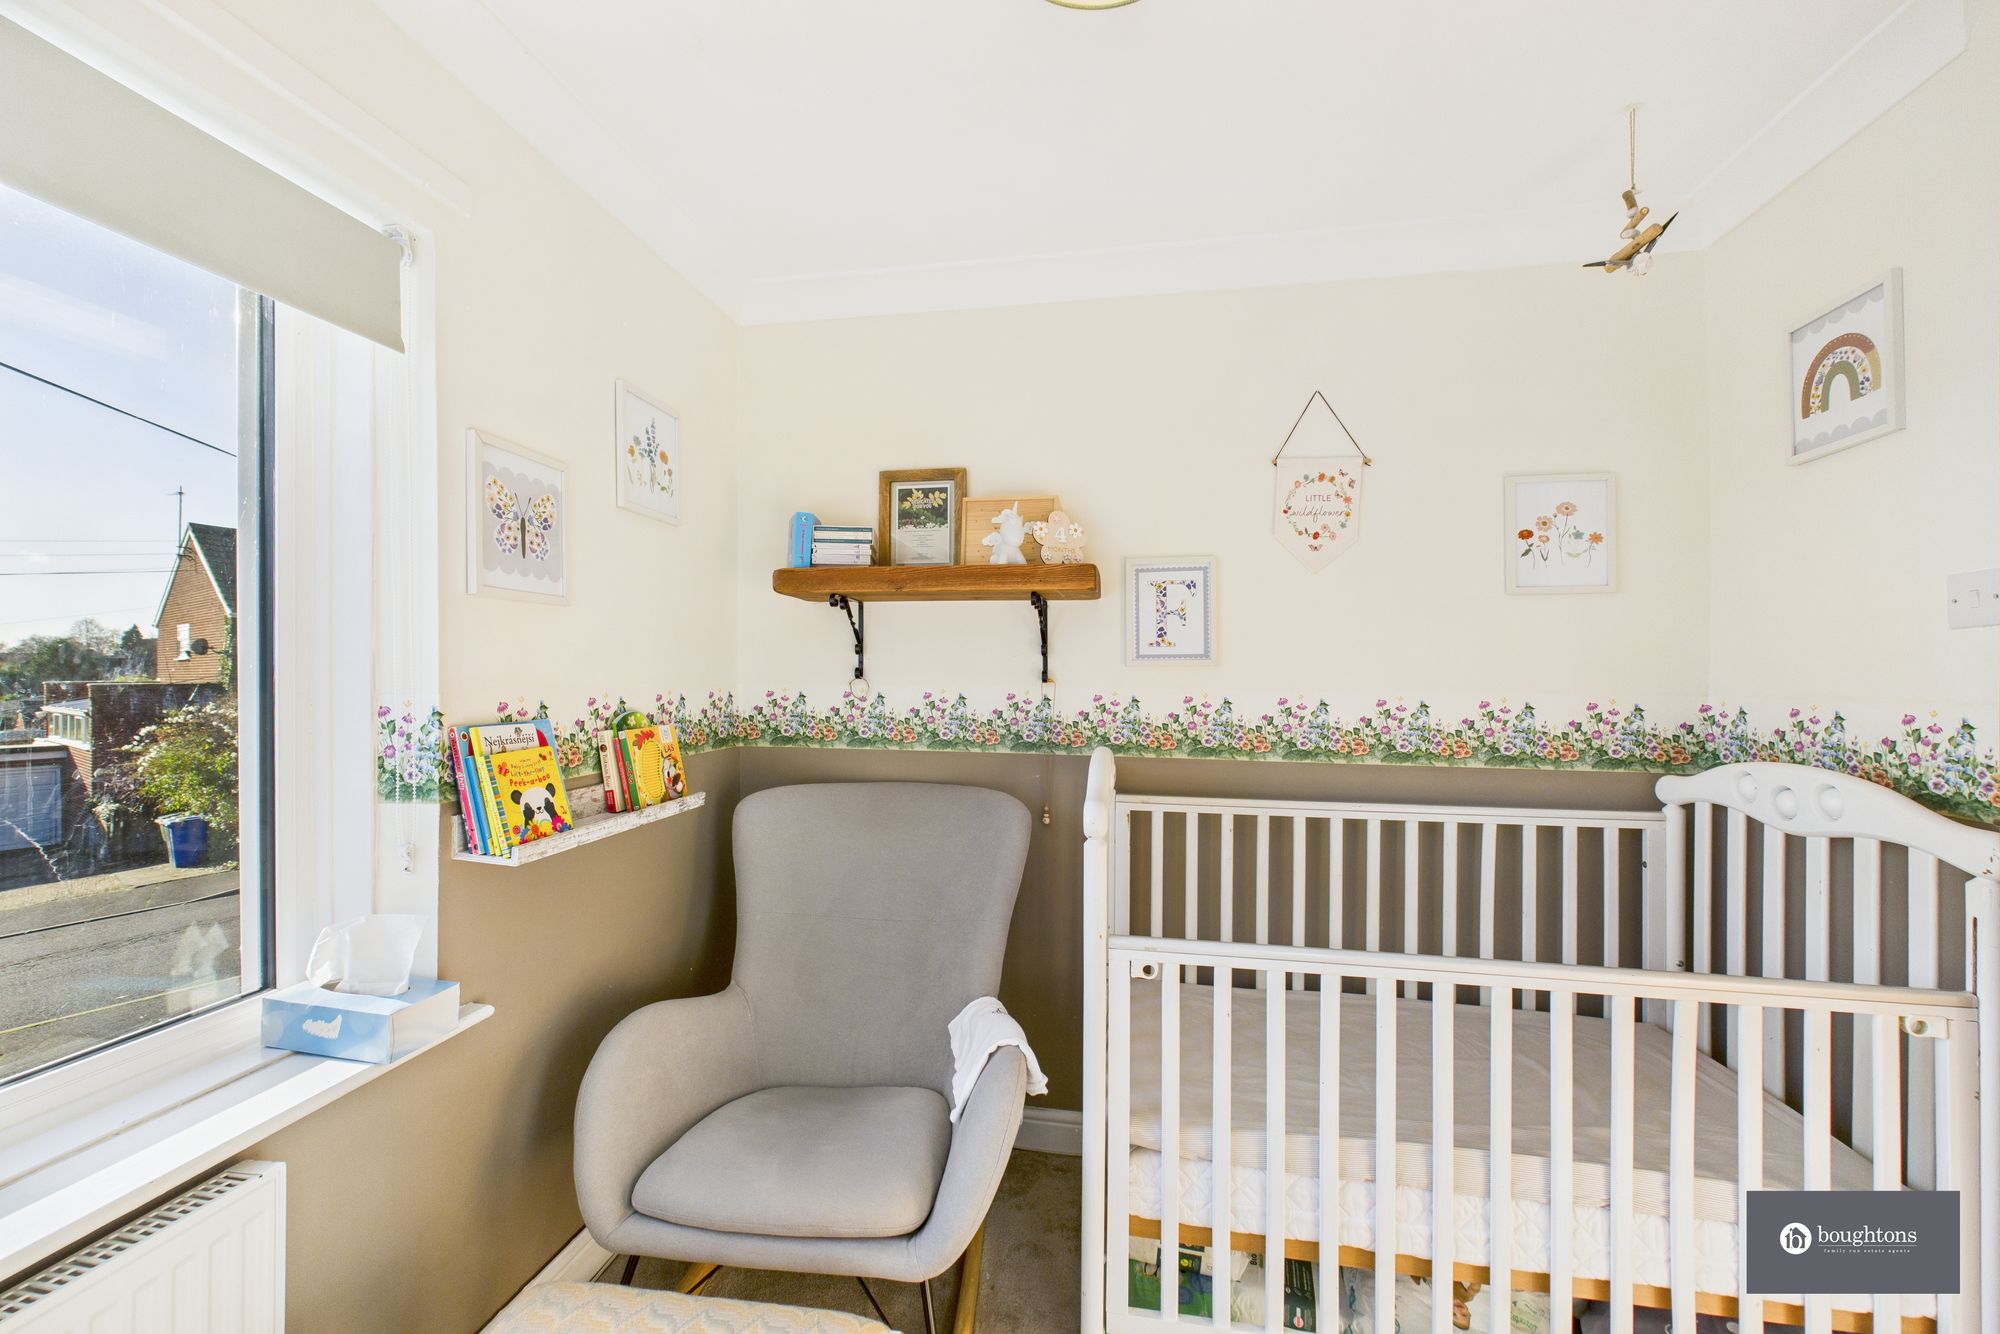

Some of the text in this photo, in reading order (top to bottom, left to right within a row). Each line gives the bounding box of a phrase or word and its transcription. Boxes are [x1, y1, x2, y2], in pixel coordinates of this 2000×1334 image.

[1305, 494, 1332, 502] LITTLE
[1292, 505, 1344, 523] wildflower
[1053, 527, 1067, 544] 4
[1148, 579, 1197, 648] F
[484, 733, 535, 748] Nejkrásnější
[663, 743, 675, 753] LAS
[509, 773, 551, 787] Peek-a-boo
